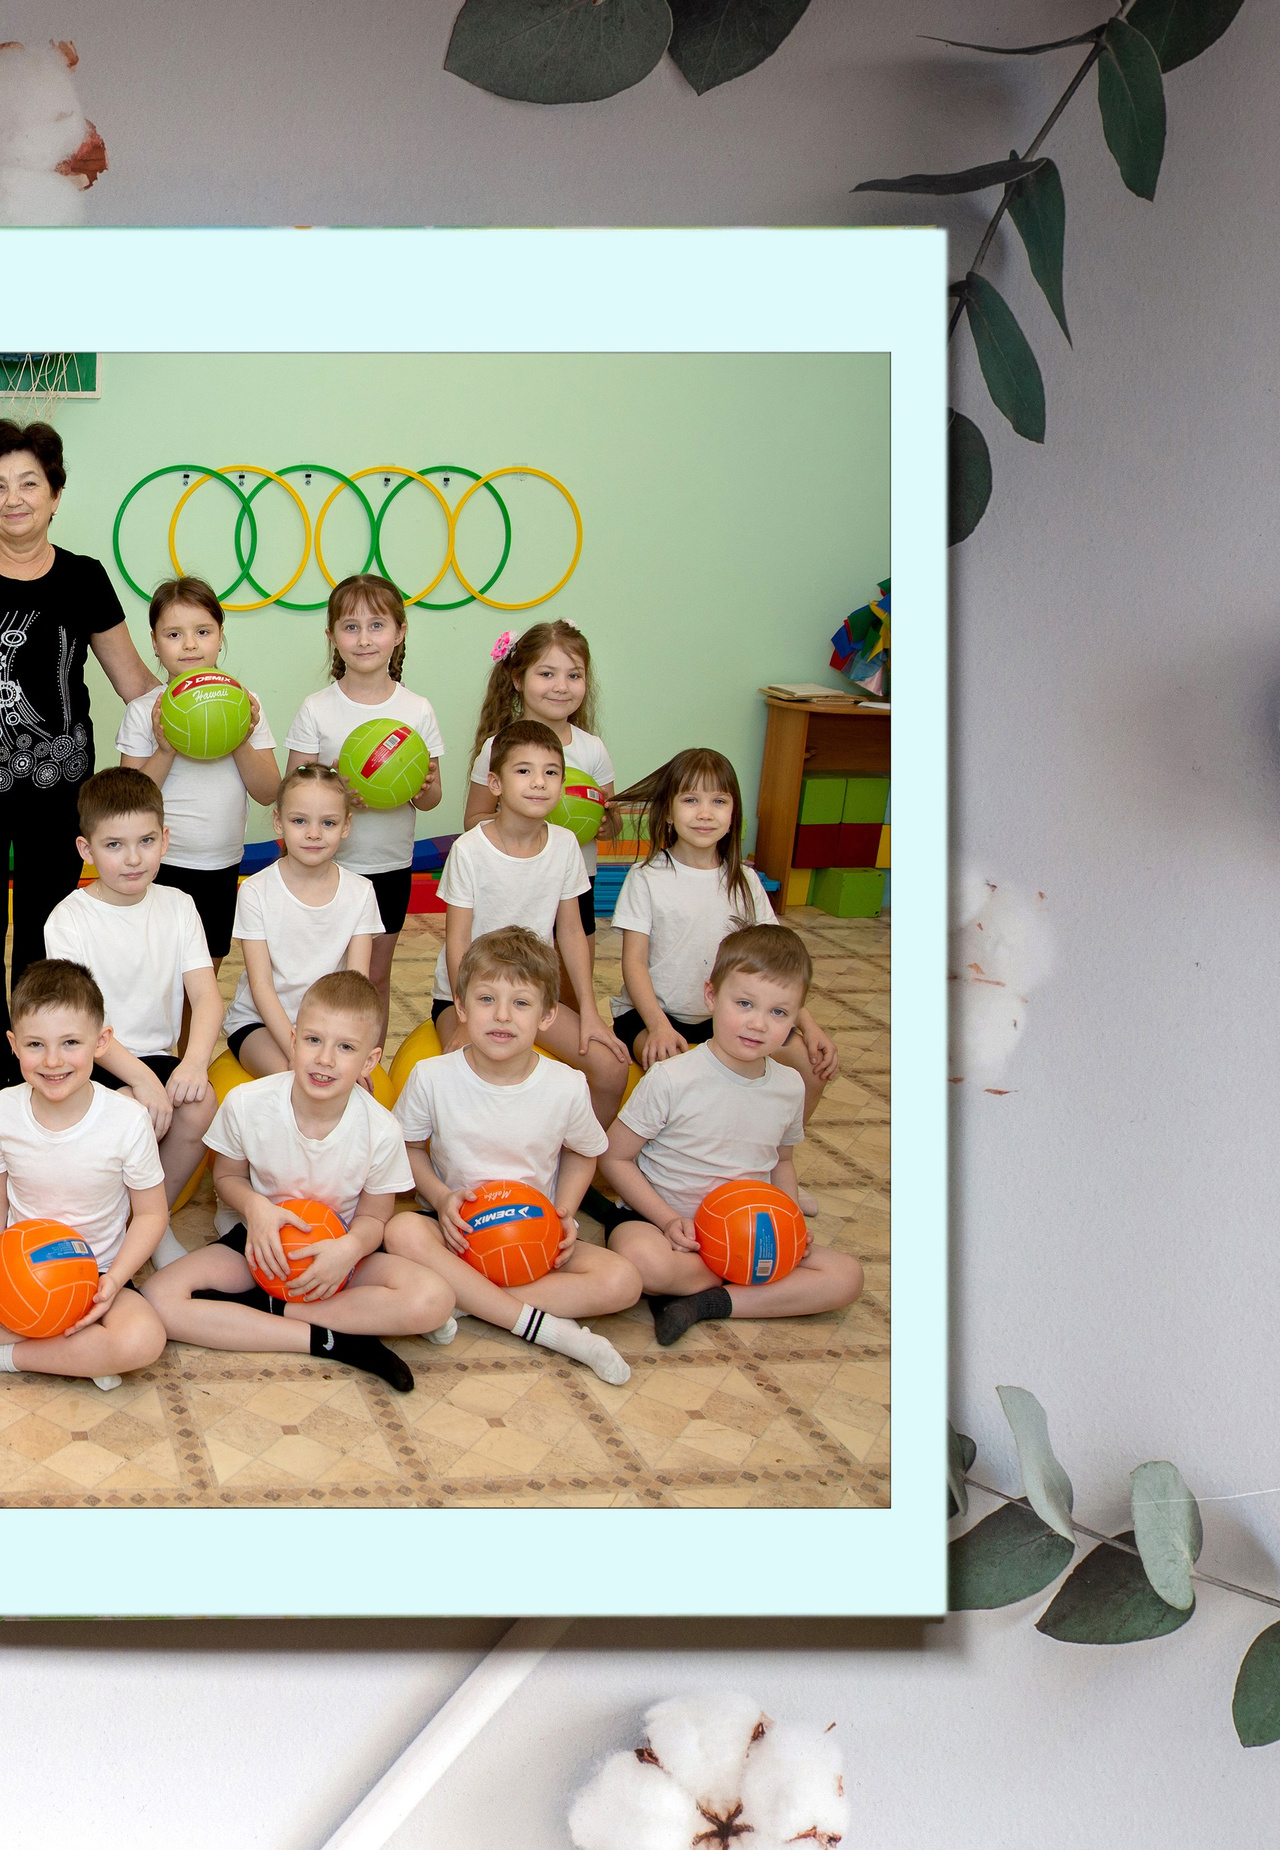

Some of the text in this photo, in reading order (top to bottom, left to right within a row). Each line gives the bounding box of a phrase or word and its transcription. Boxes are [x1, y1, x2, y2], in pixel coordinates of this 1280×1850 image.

[195, 675, 231, 684] DEMIX
[192, 687, 229, 702] Hawaii
[474, 1209, 515, 1227] DEMIX
